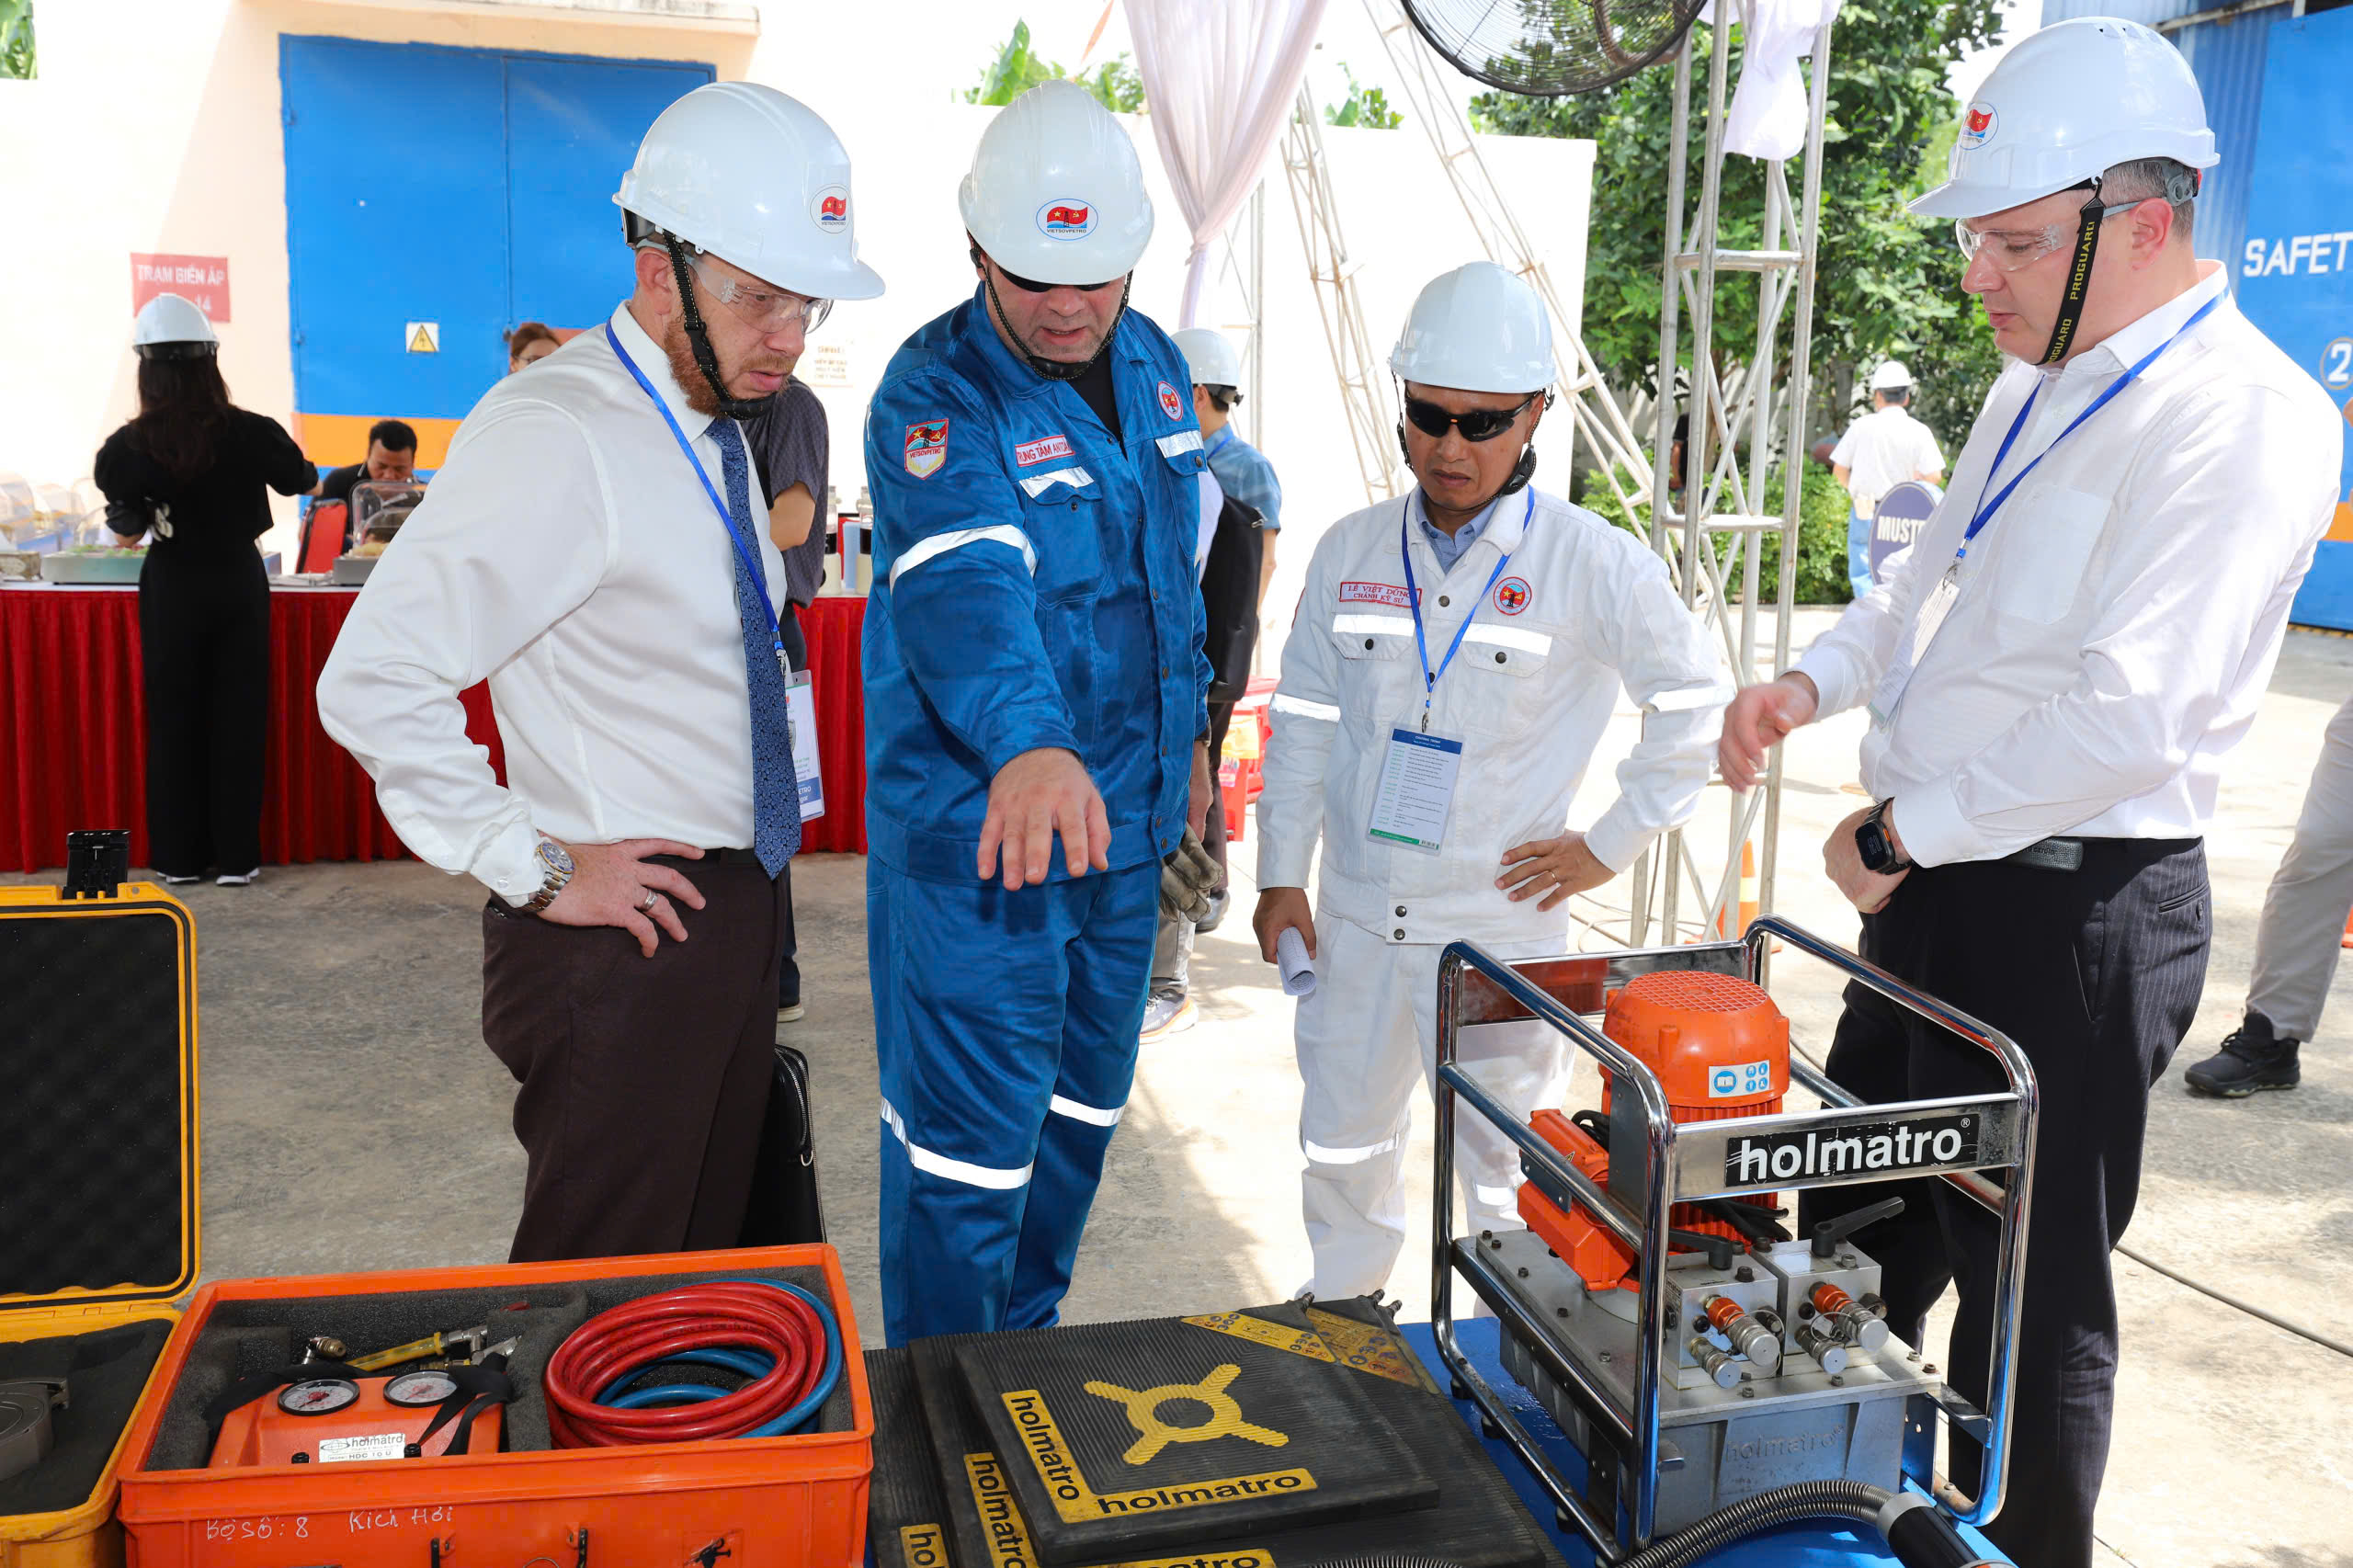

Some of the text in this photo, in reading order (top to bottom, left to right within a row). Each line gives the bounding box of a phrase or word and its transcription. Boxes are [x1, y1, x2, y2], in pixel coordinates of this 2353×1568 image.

[2069, 221, 2096, 301] PROGUARD
[2048, 317, 2073, 363] OGUARD
[2328, 342, 2352, 383] 2
[1876, 515, 1927, 547] MUST
[1739, 1126, 1963, 1182] holmatro
[1011, 1395, 1081, 1501] holmatro
[1097, 1475, 1302, 1515] holmatro
